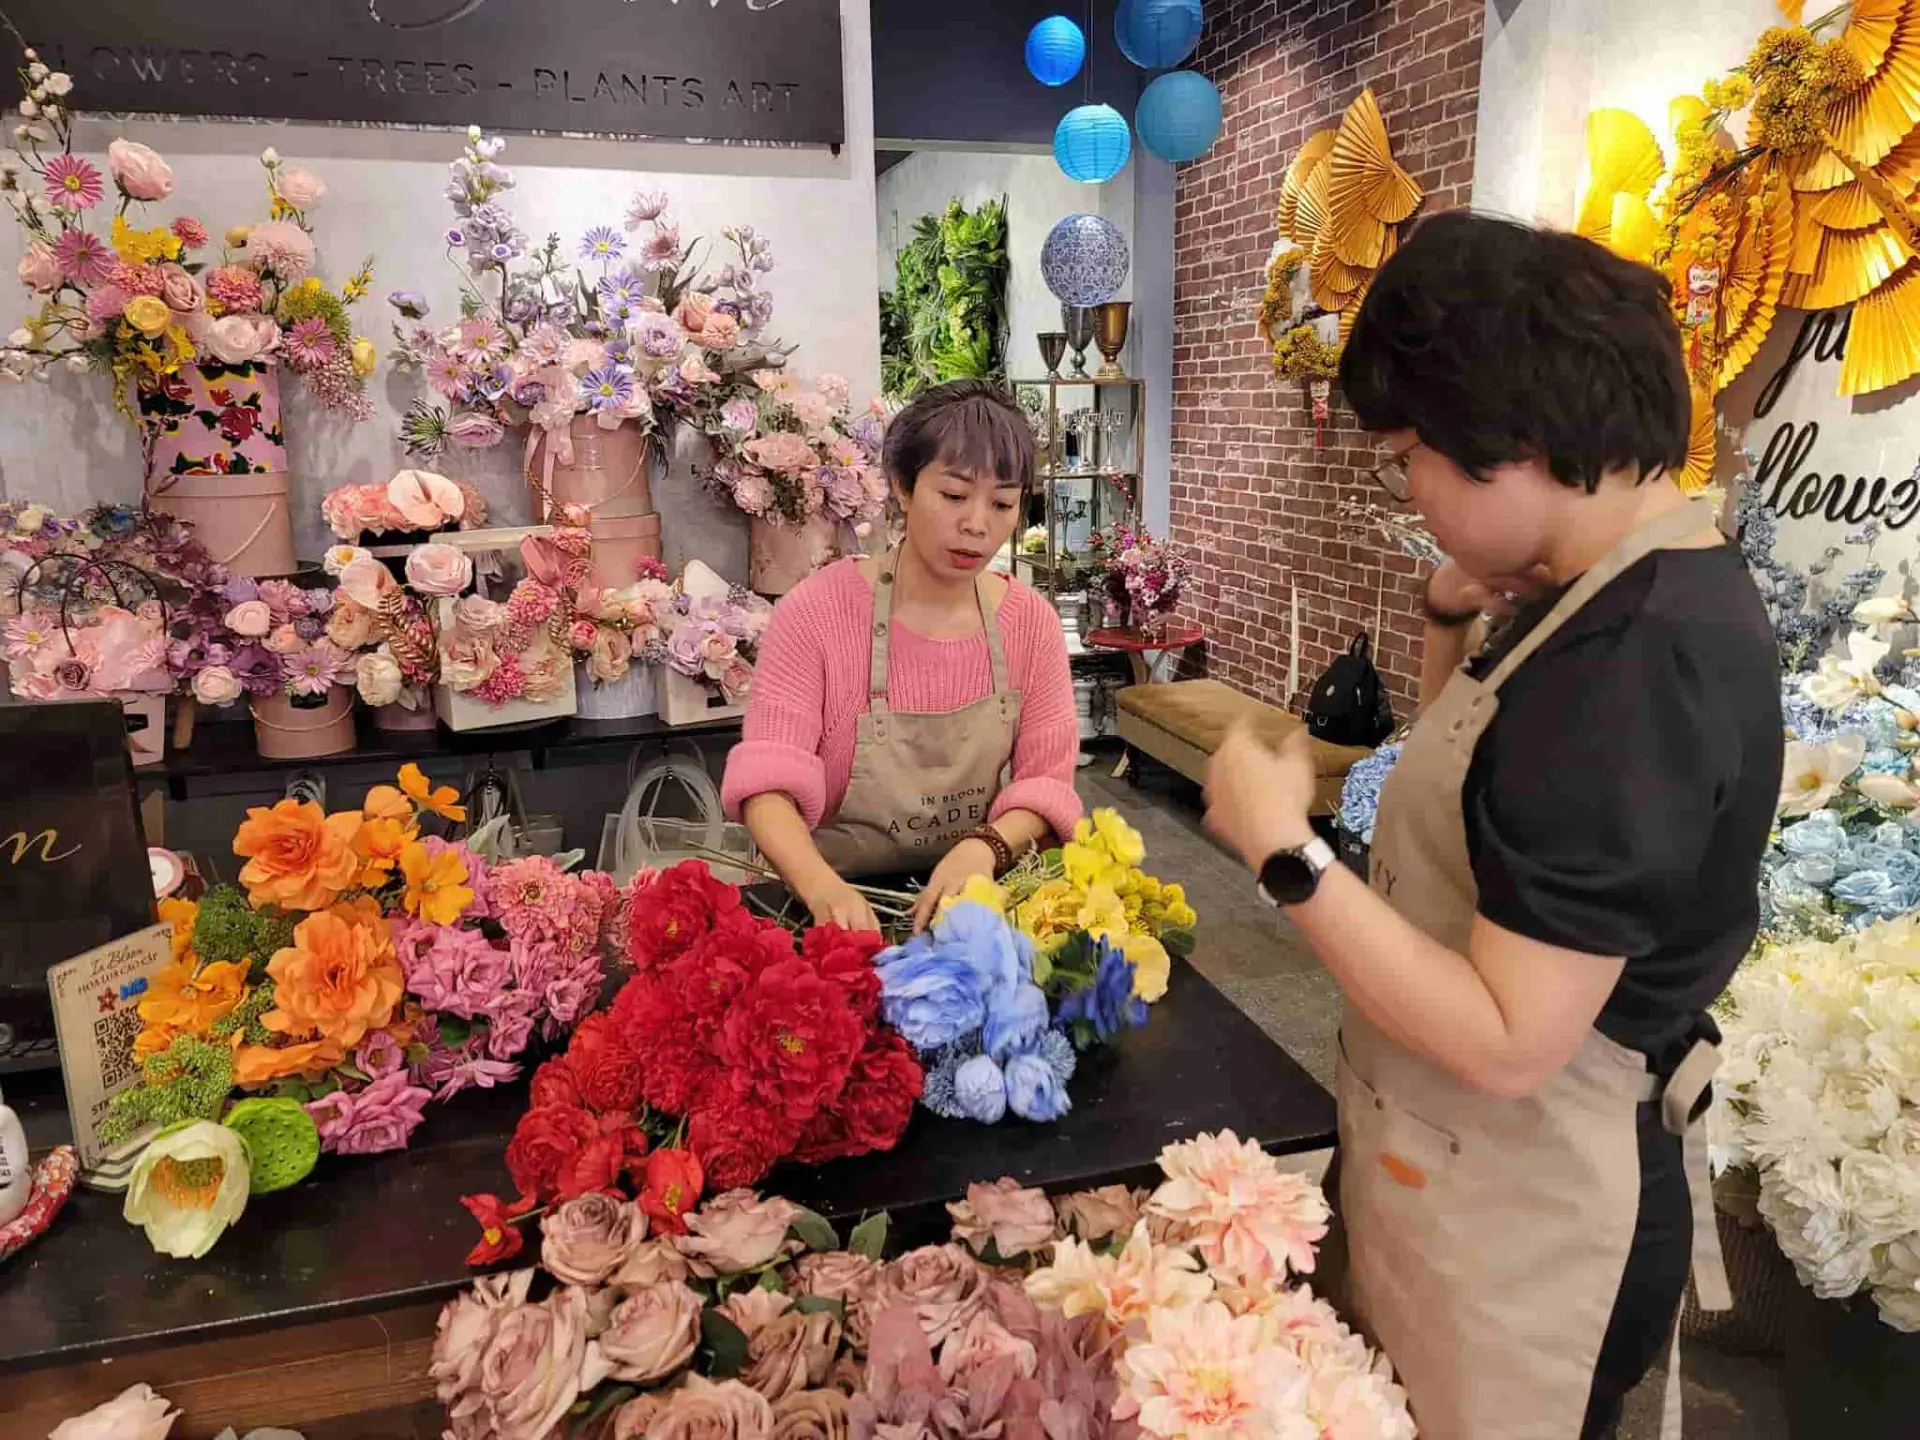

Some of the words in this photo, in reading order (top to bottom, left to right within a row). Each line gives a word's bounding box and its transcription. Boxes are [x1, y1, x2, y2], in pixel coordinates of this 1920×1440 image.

[327, 55, 477, 97] TREES
[533, 67, 704, 108] PLANTS
[721, 79, 800, 113] ART
[920, 796, 936, 807] IN
[942, 786, 986, 803] BLOOM
